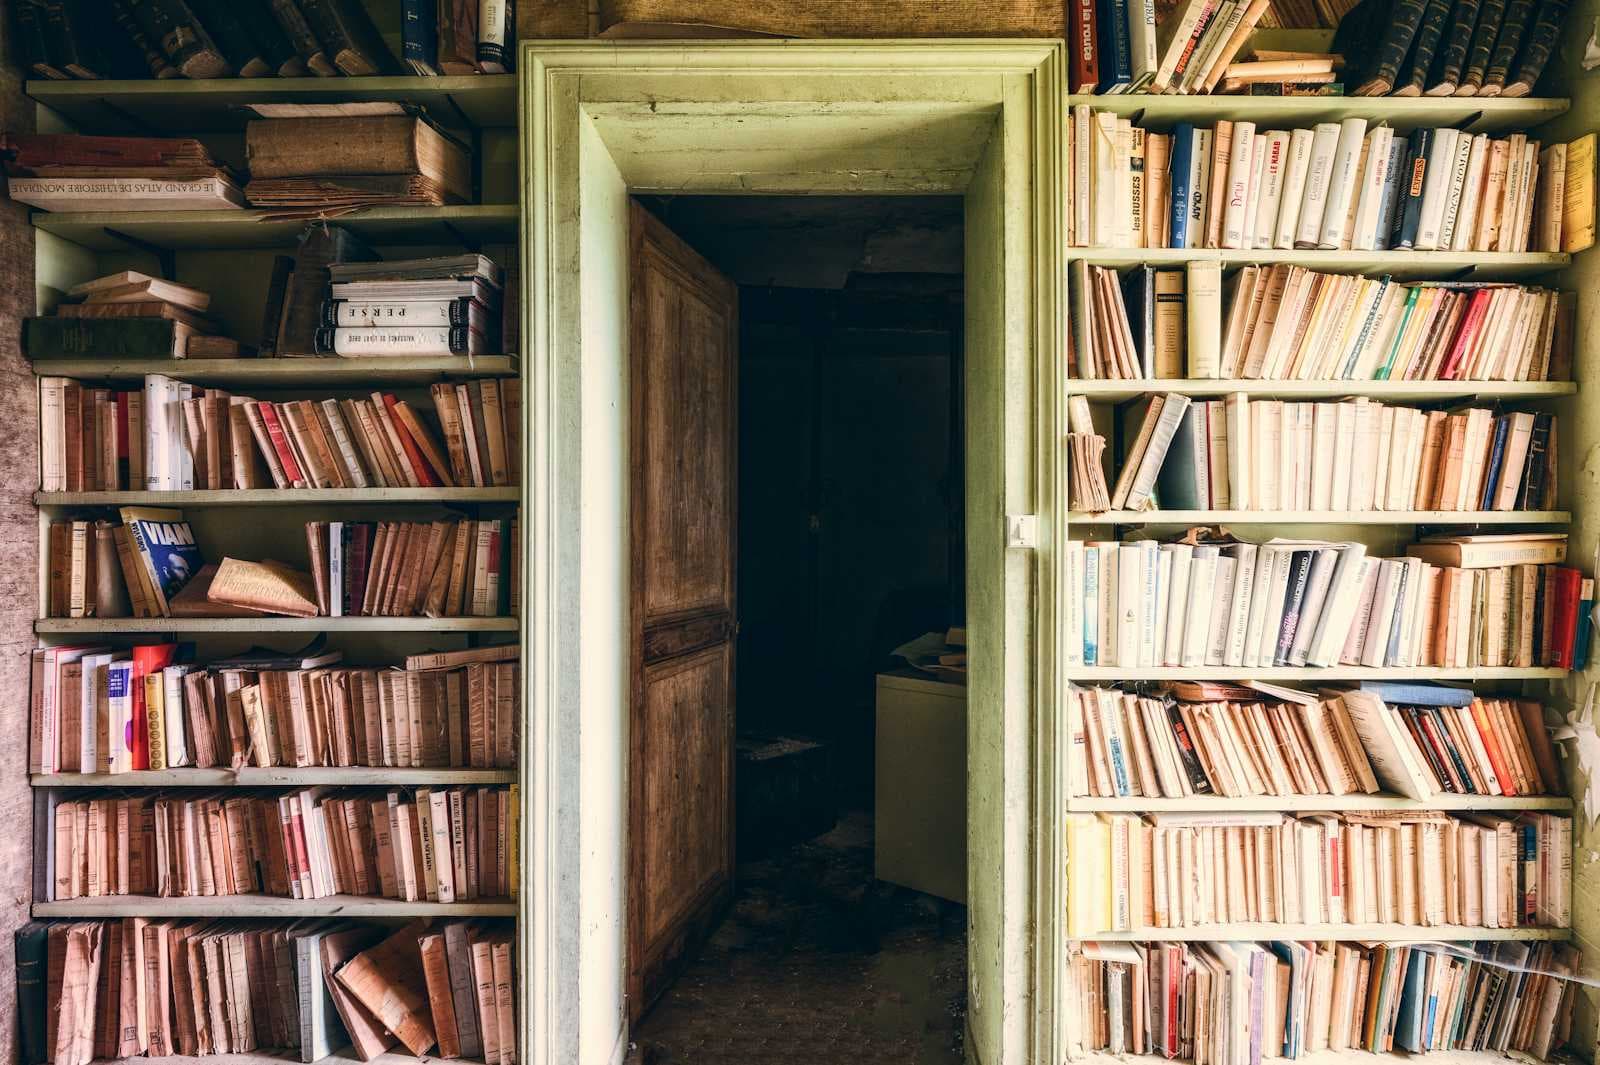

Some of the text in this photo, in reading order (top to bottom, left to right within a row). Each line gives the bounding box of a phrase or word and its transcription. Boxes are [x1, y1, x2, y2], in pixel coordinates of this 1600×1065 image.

[1083, 9, 1092, 21] la
[1083, 24, 1092, 61] route
[12, 183, 214, 193] LE GRAND ATLAS DE L'HISTOIRE MONDIALE
[1411, 159, 1424, 196] L'EXPRESS
[1132, 176, 1140, 231] les RUSSES
[349, 308, 405, 317] PERSE
[142, 521, 195, 545] VIAN
